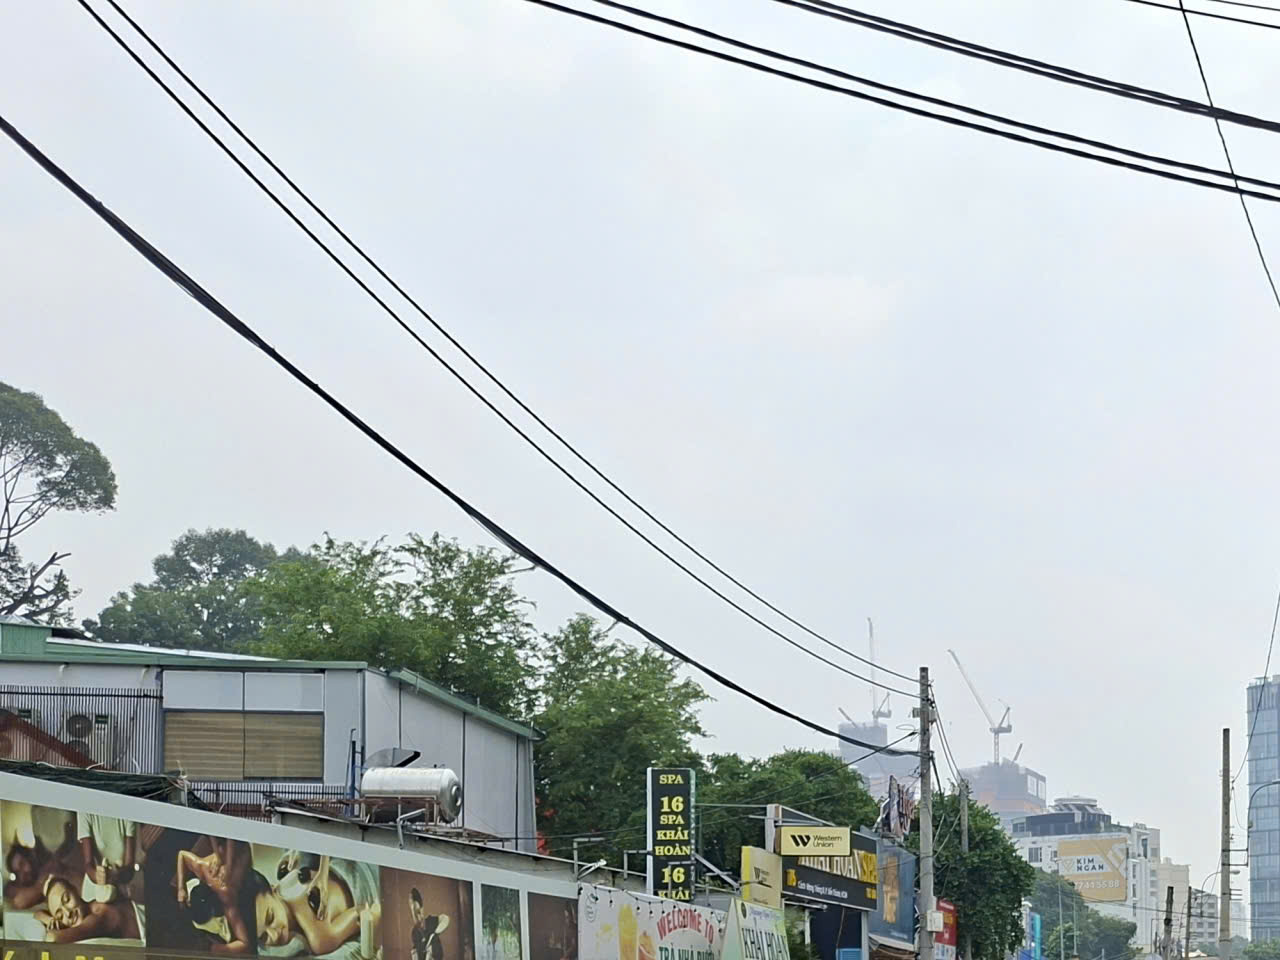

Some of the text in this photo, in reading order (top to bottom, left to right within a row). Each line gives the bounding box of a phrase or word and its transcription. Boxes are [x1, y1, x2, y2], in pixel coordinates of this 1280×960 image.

[659, 774, 684, 784] SPA
[660, 796, 684, 812] 16
[660, 815, 685, 824] SPA
[655, 843, 691, 855] HOÀN
[661, 867, 685, 883] 16
[657, 908, 714, 944] WELCOME TO
